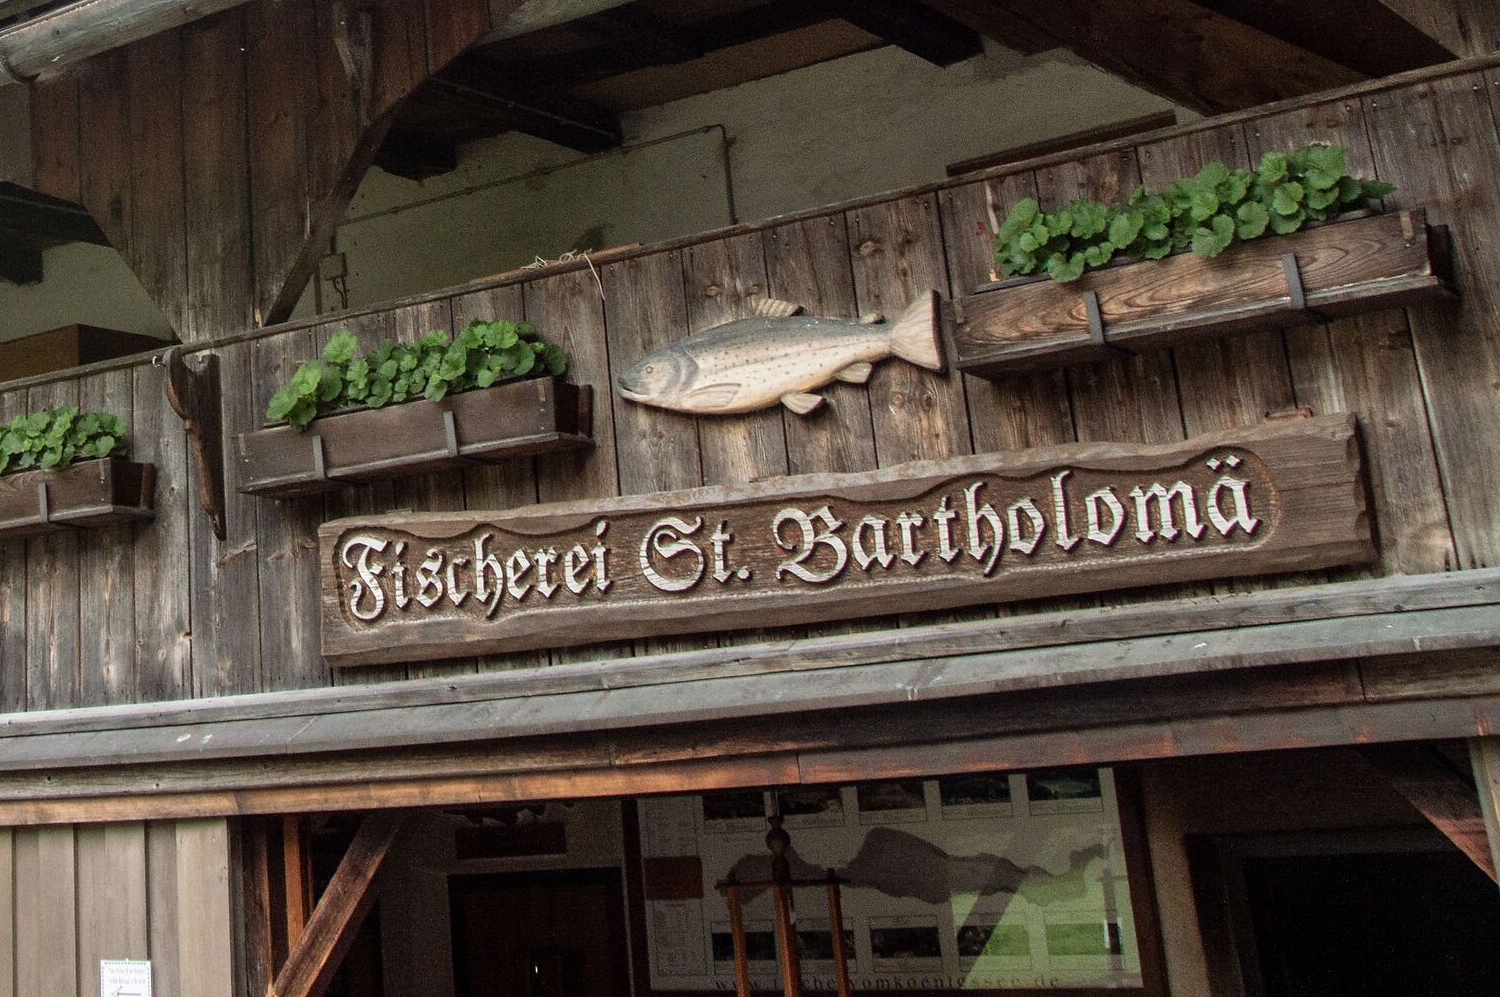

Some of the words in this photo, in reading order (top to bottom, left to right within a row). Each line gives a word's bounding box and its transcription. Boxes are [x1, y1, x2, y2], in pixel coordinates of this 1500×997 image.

[342, 520, 611, 621] Fischerei
[639, 515, 750, 592] St.
[772, 454, 1262, 583] Bartholomä
